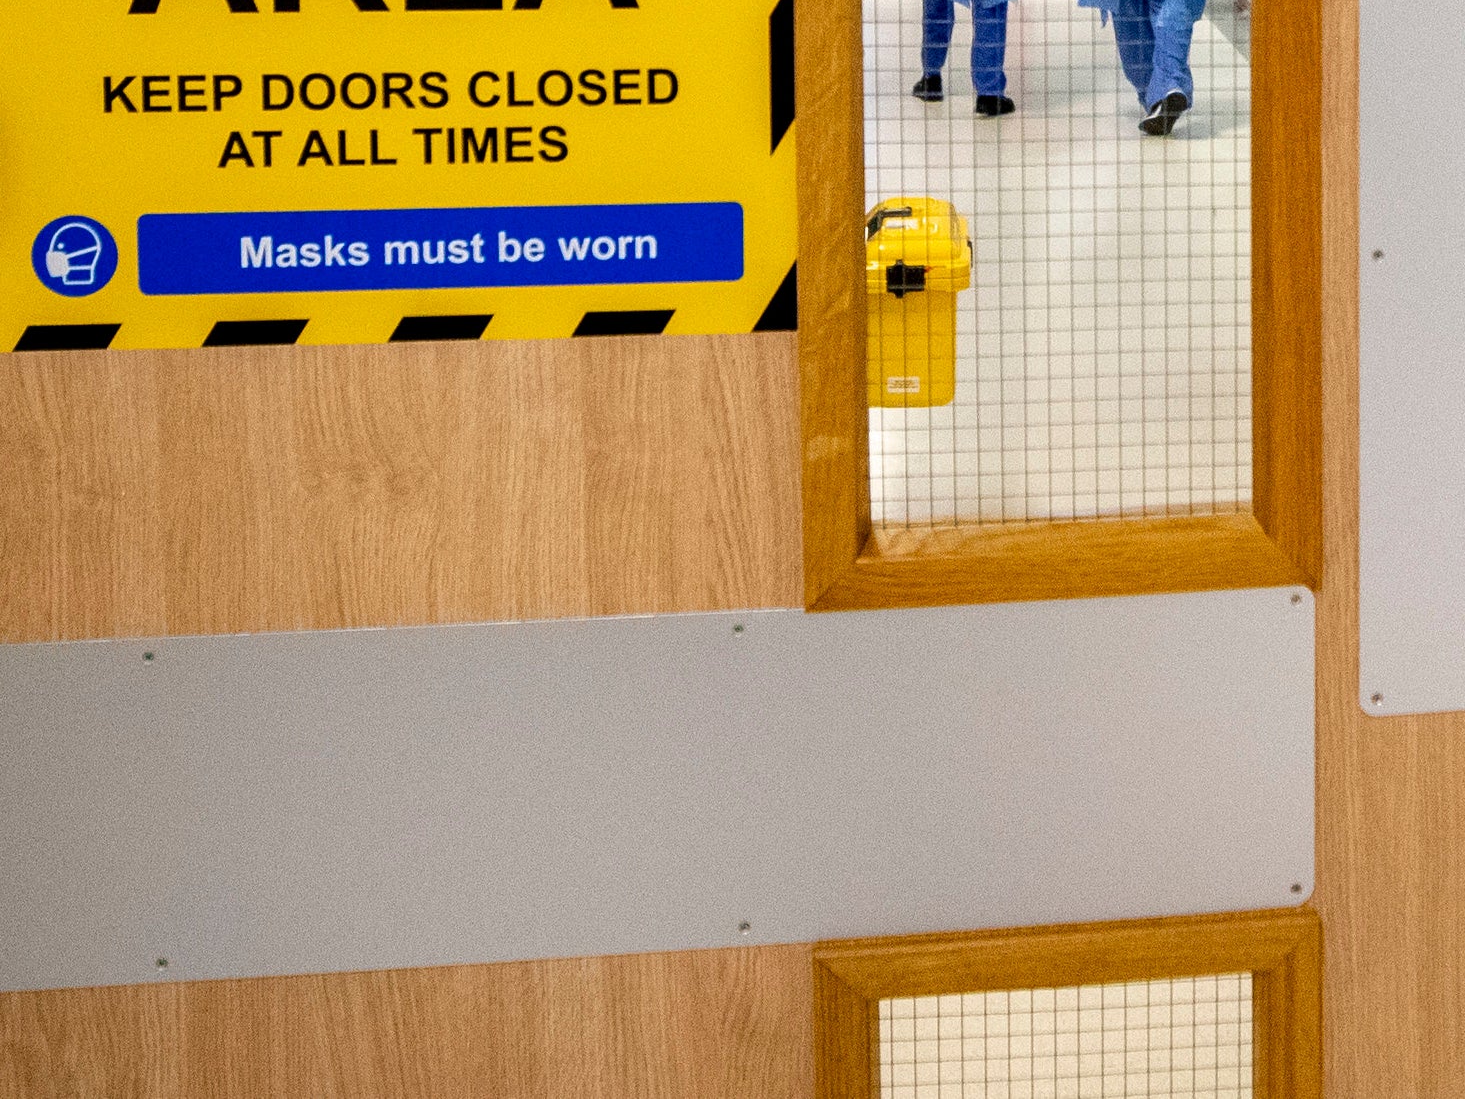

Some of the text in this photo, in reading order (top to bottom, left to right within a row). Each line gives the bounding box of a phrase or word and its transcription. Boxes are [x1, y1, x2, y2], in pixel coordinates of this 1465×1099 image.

[102, 68, 680, 114] KEEP DOORS CLOSED
[218, 124, 570, 169] AT ALL TIMES
[240, 231, 659, 270] Masks must be worn
